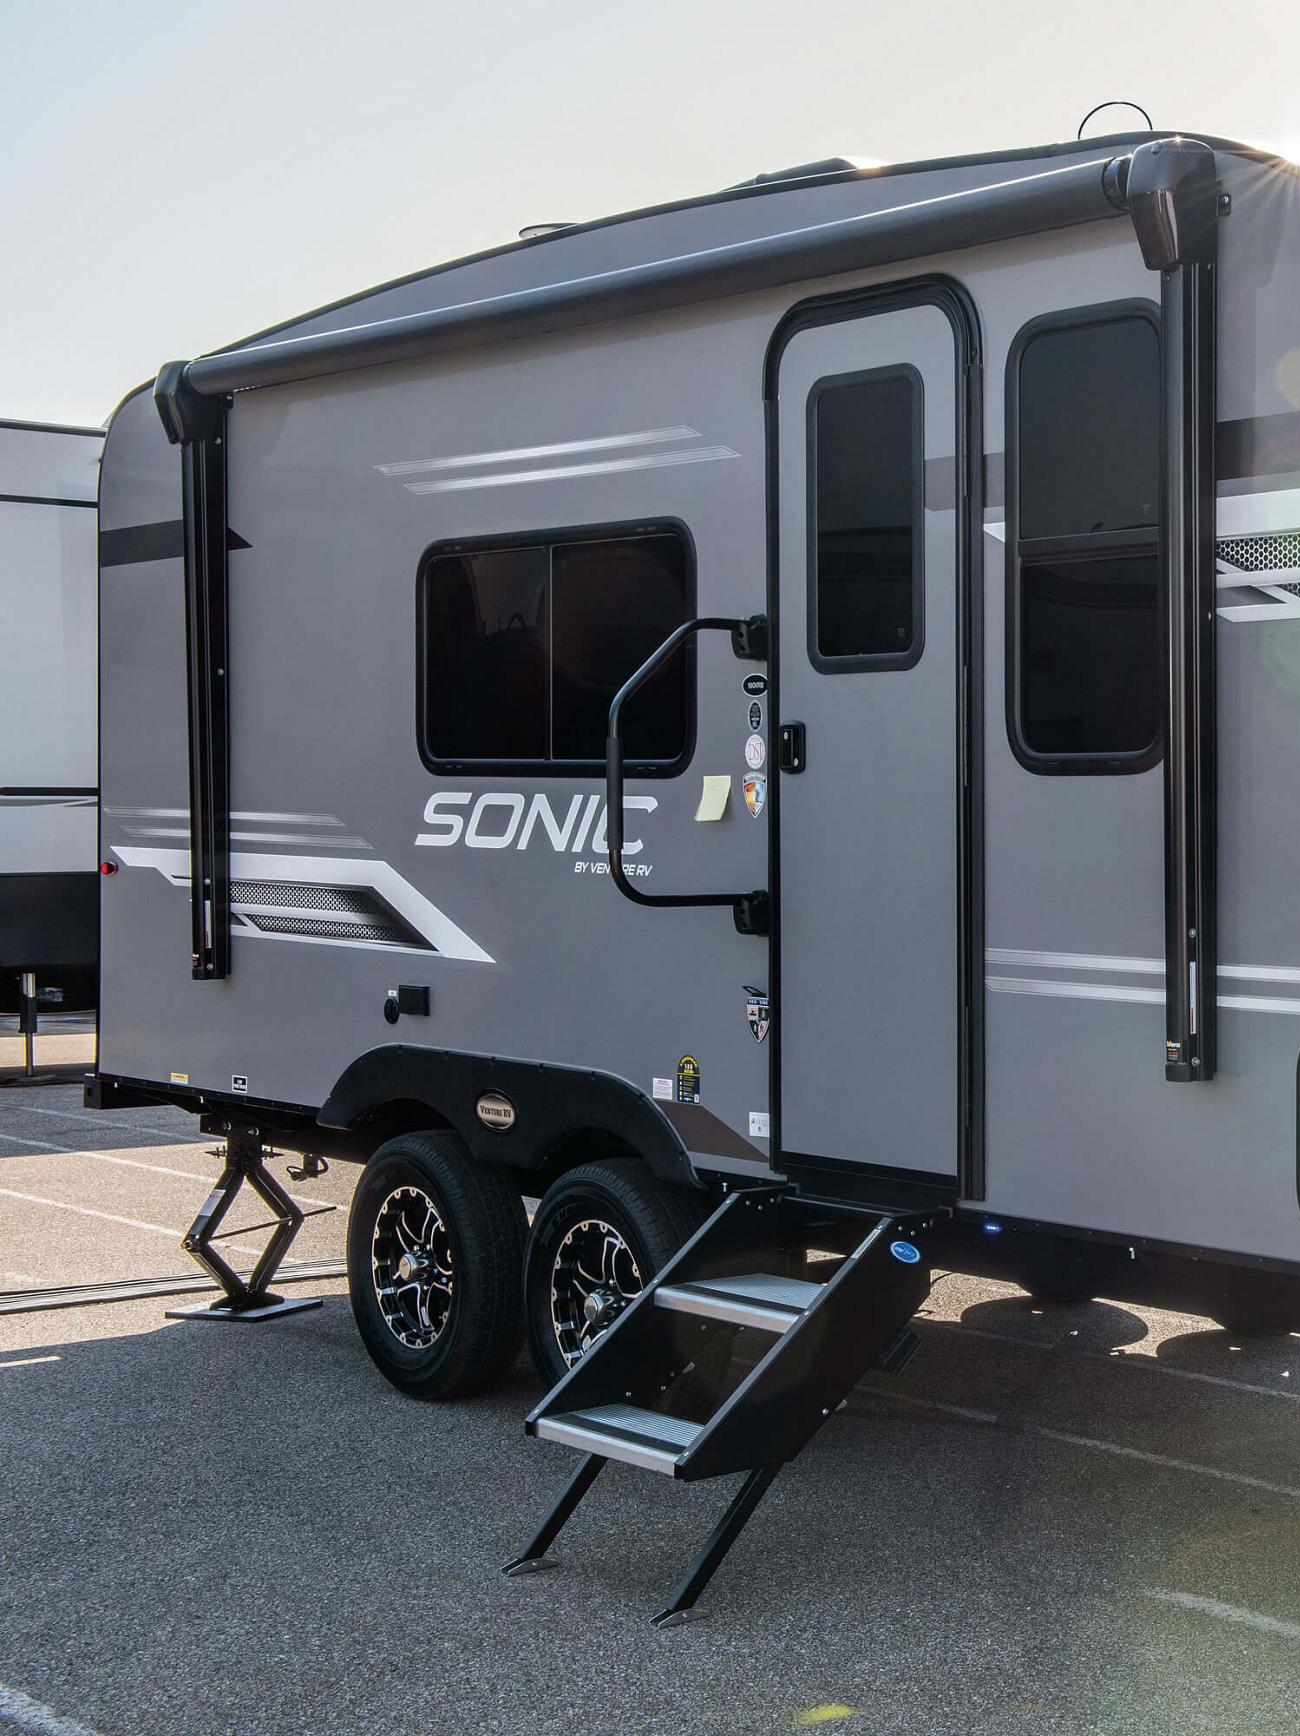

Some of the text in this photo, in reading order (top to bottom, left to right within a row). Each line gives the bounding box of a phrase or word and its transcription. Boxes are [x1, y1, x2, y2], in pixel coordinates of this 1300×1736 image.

[414, 792, 659, 855] SONIC
[574, 861, 653, 877] BY VENRE RV
